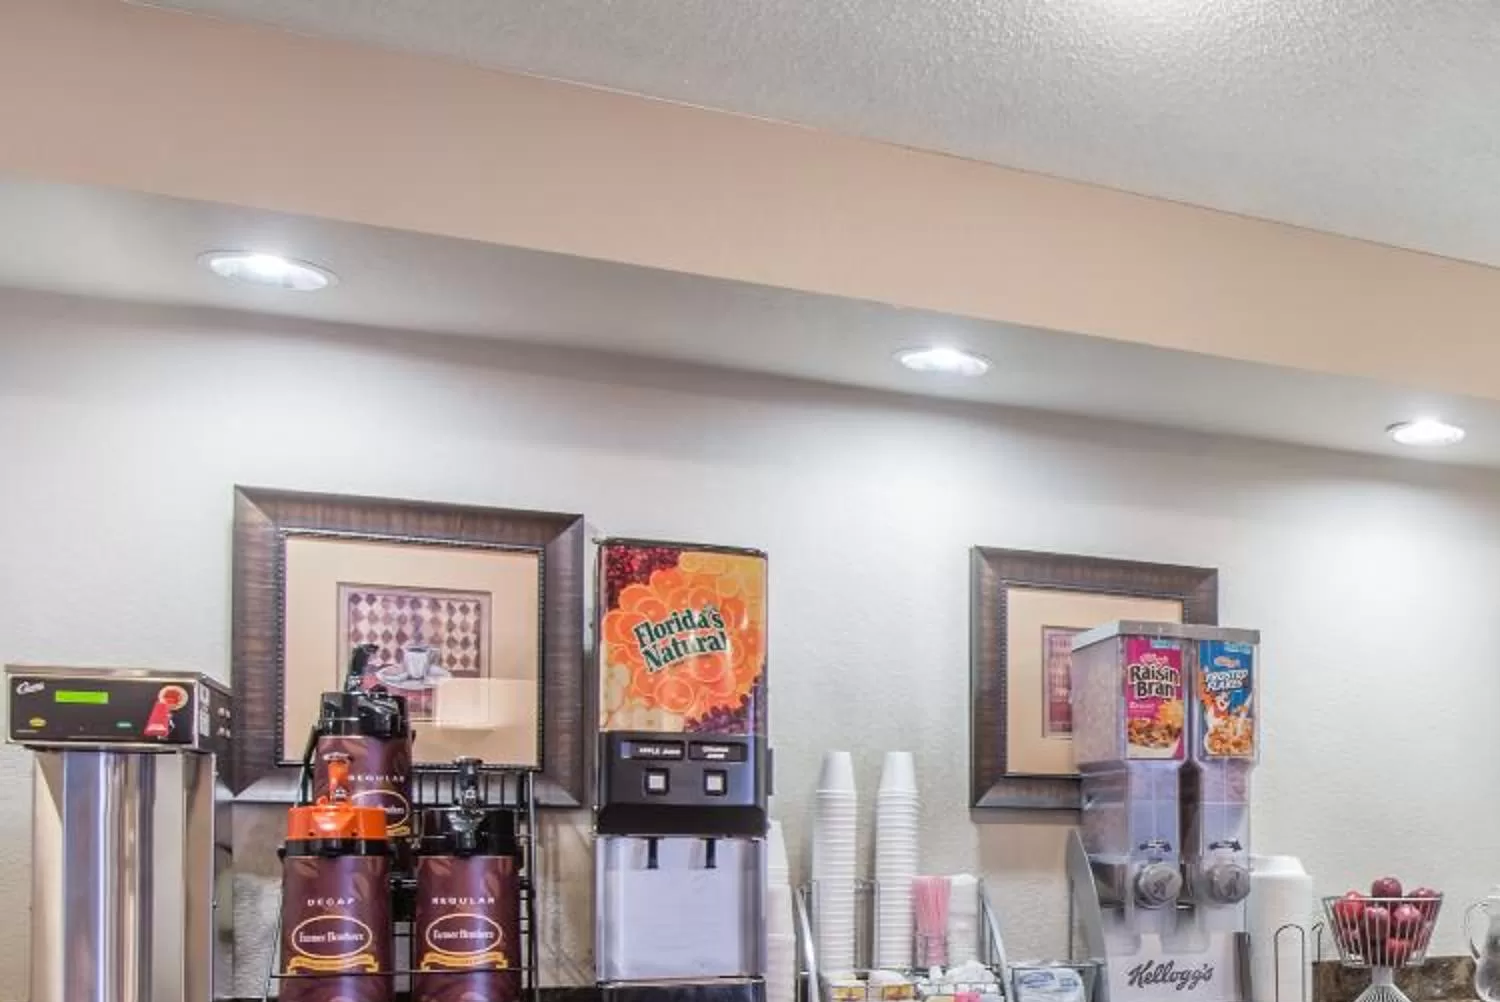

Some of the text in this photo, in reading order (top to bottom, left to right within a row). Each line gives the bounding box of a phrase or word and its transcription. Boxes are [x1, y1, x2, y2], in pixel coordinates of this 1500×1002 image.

[633, 607, 725, 648] Florida's
[641, 631, 728, 673] Natural
[1129, 665, 1178, 682] Raisin
[1136, 682, 1175, 698] Bran
[431, 896, 496, 905] REGULAR
[1128, 959, 1214, 991] Kellogg's
